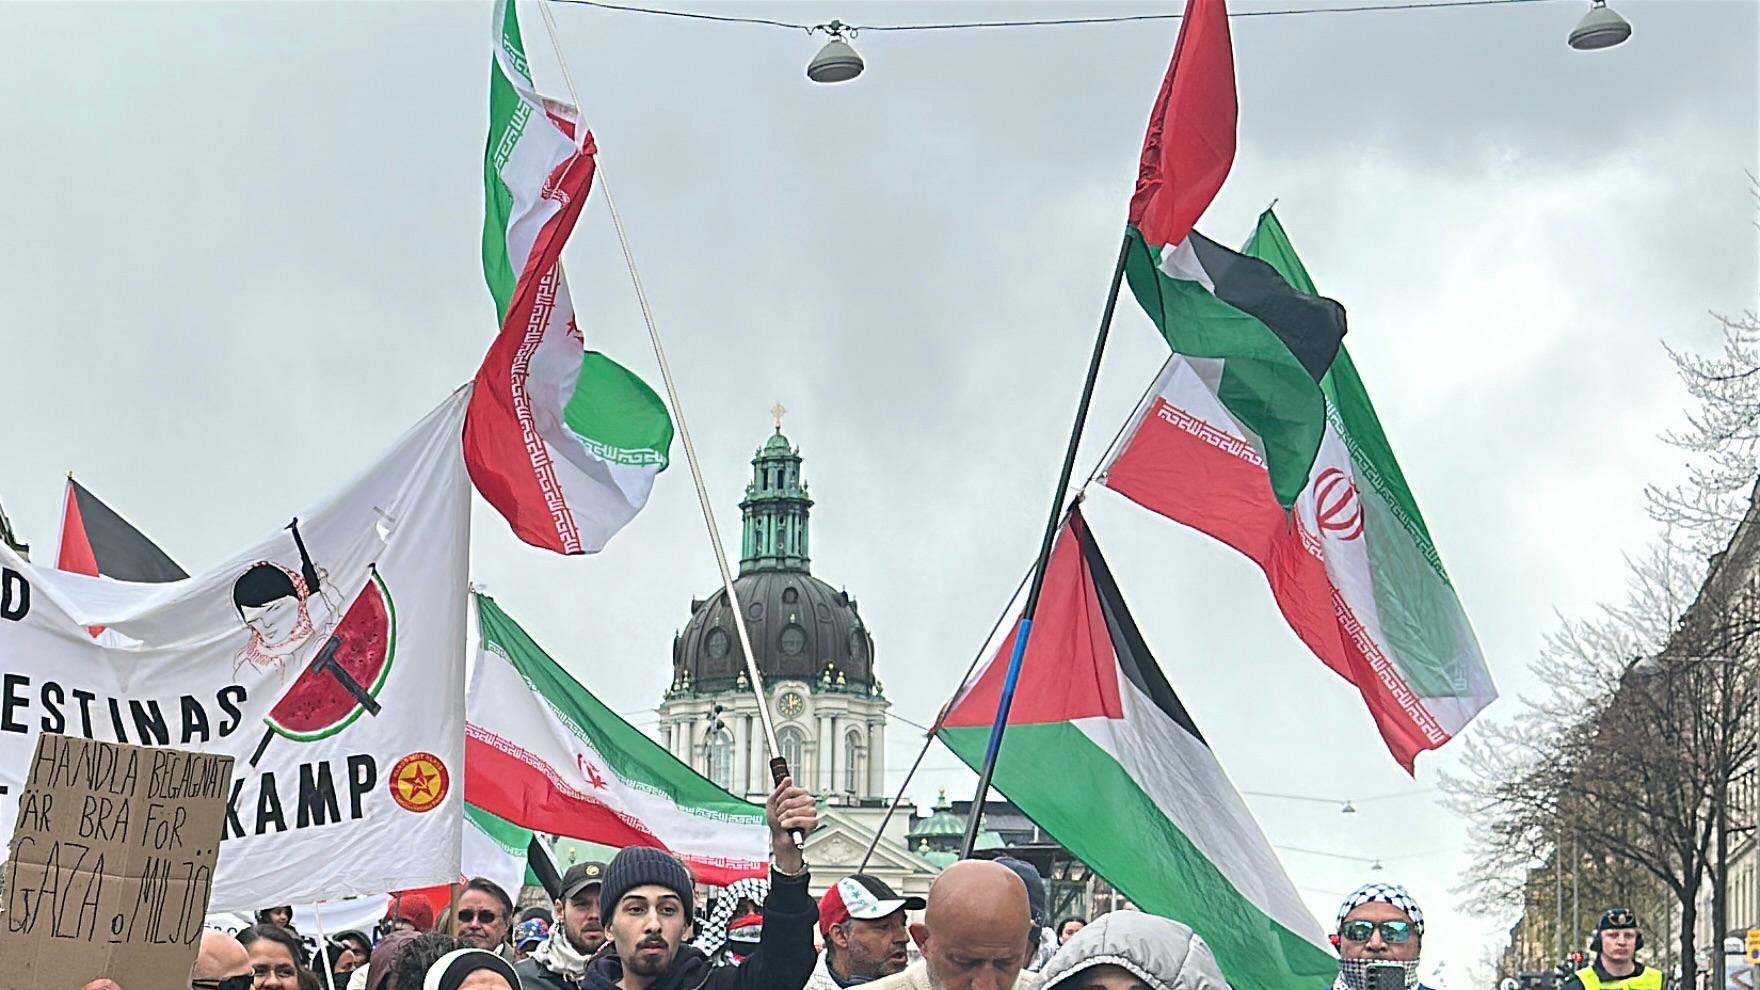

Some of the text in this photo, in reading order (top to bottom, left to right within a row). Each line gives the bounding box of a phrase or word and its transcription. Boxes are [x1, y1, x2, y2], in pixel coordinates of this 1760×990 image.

[33, 733, 234, 799] HANDLA BEGAGNAT
[20, 789, 53, 832] ÄR
[79, 795, 130, 844] BRA
[9, 836, 105, 942] GAZA
[127, 849, 214, 946] MILJÖ
